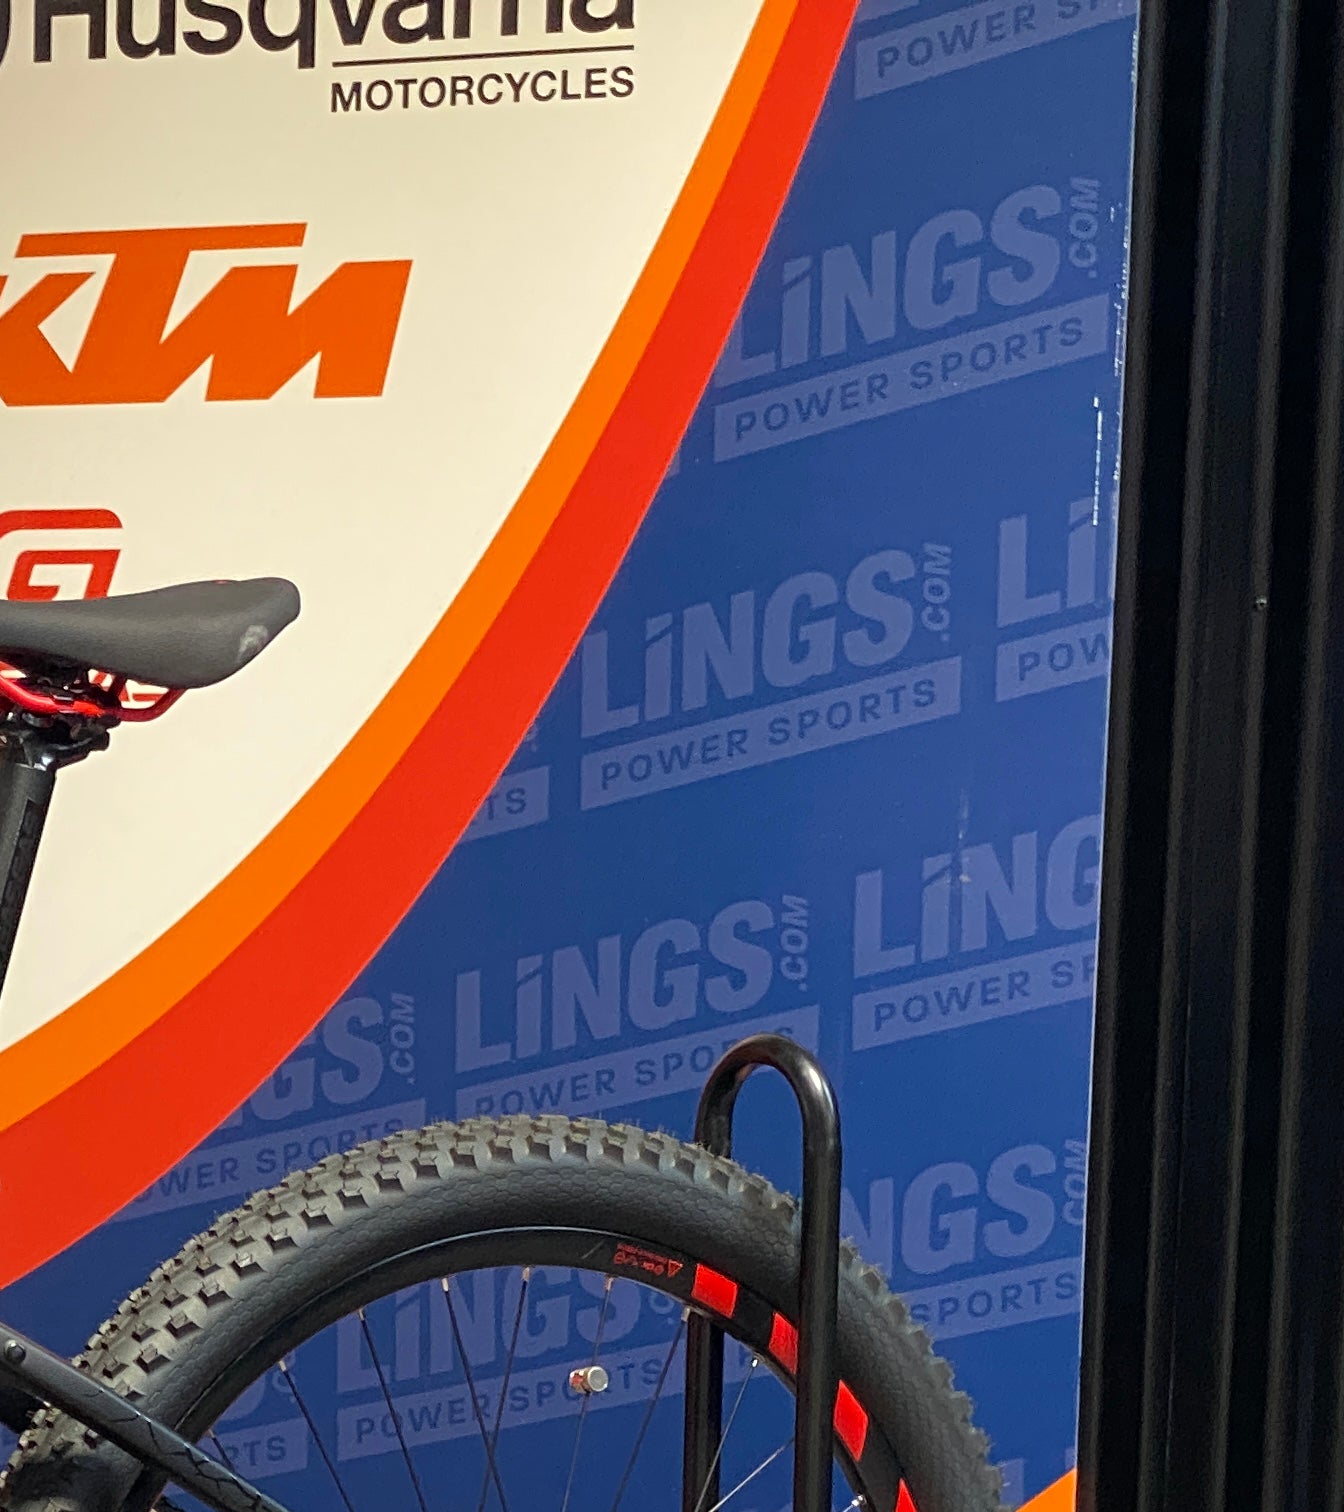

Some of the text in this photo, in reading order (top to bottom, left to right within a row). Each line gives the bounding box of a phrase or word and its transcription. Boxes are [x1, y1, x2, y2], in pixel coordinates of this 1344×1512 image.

[330, 66, 635, 114] MOTORCYCLES
[735, 317, 1085, 442] POWER SPORTS
[601, 678, 936, 790] POWER SPORTS
[874, 968, 1031, 1032] POWER
[356, 1391, 490, 1445] POWER
